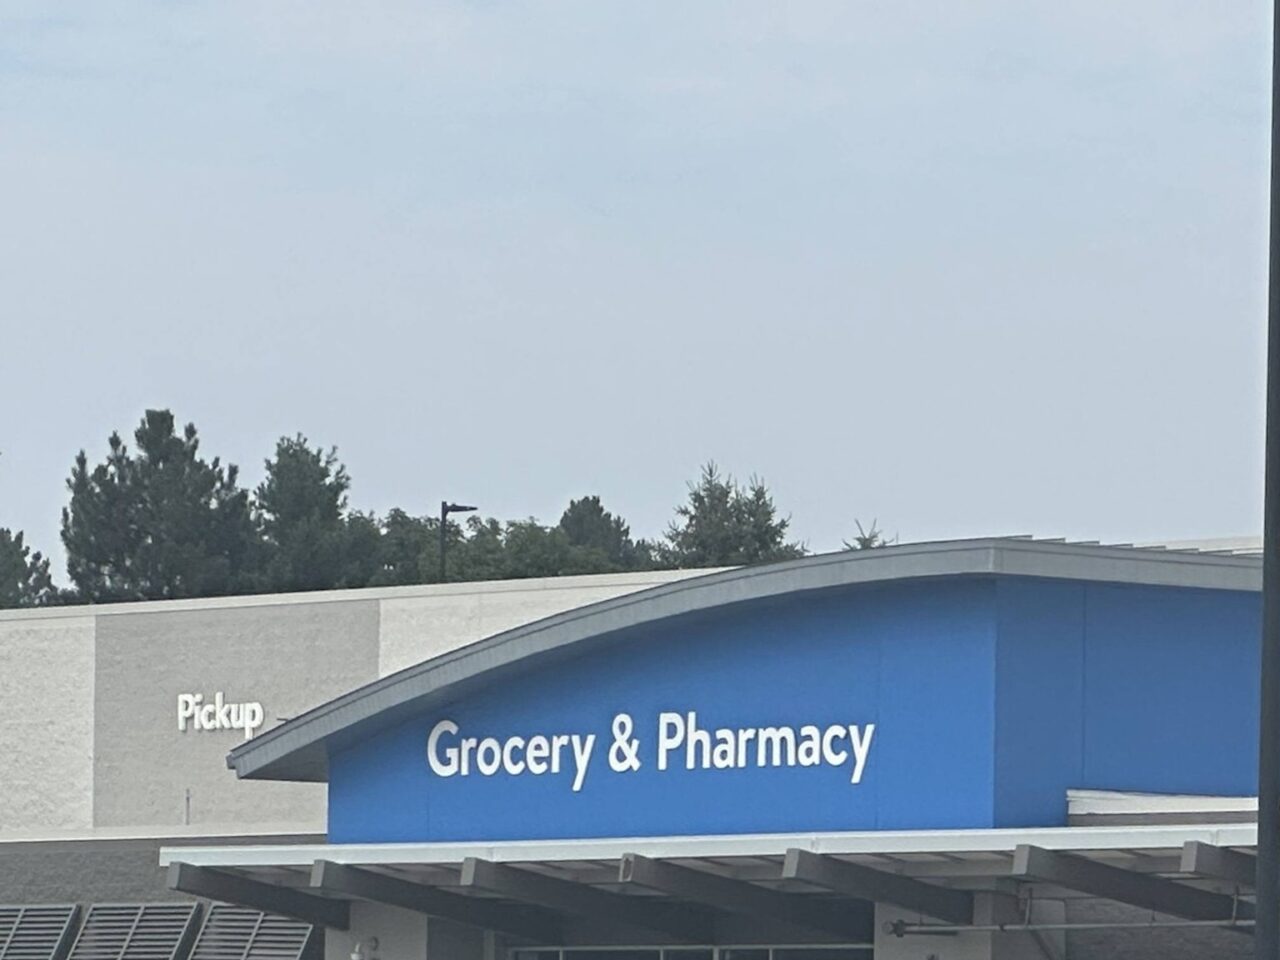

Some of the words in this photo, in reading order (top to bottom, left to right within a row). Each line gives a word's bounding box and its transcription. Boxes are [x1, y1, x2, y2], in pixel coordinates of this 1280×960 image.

[178, 692, 264, 740] Pickup
[427, 719, 596, 792] Grocery
[608, 713, 641, 772] &
[658, 711, 875, 784] Pharmacy
